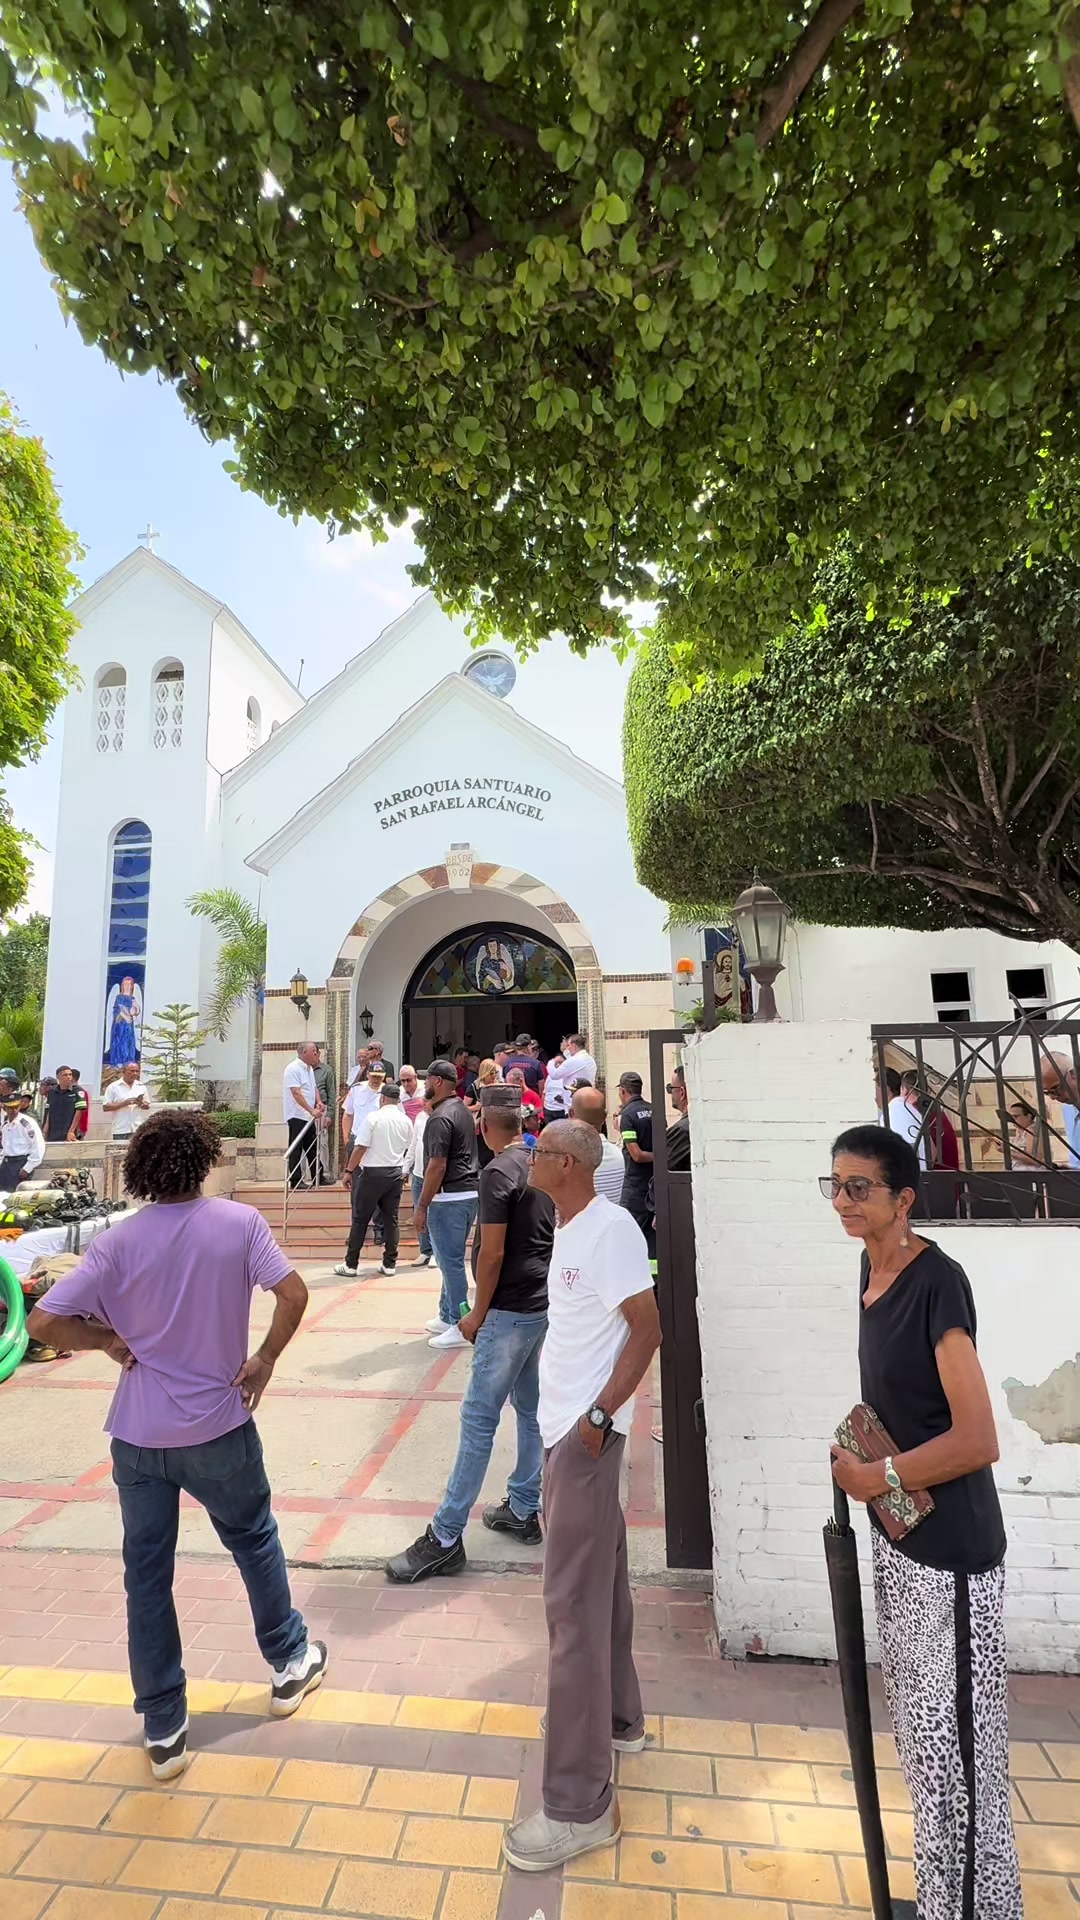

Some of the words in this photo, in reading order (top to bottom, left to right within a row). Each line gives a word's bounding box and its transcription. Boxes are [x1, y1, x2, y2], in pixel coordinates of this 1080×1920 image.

[373, 779, 461, 813] PARROQUIA
[464, 777, 551, 802] SANTUARIO
[380, 809, 407, 830] SAN
[409, 797, 464, 818] RAFAEL
[466, 795, 544, 821] ARCÁNGEL
